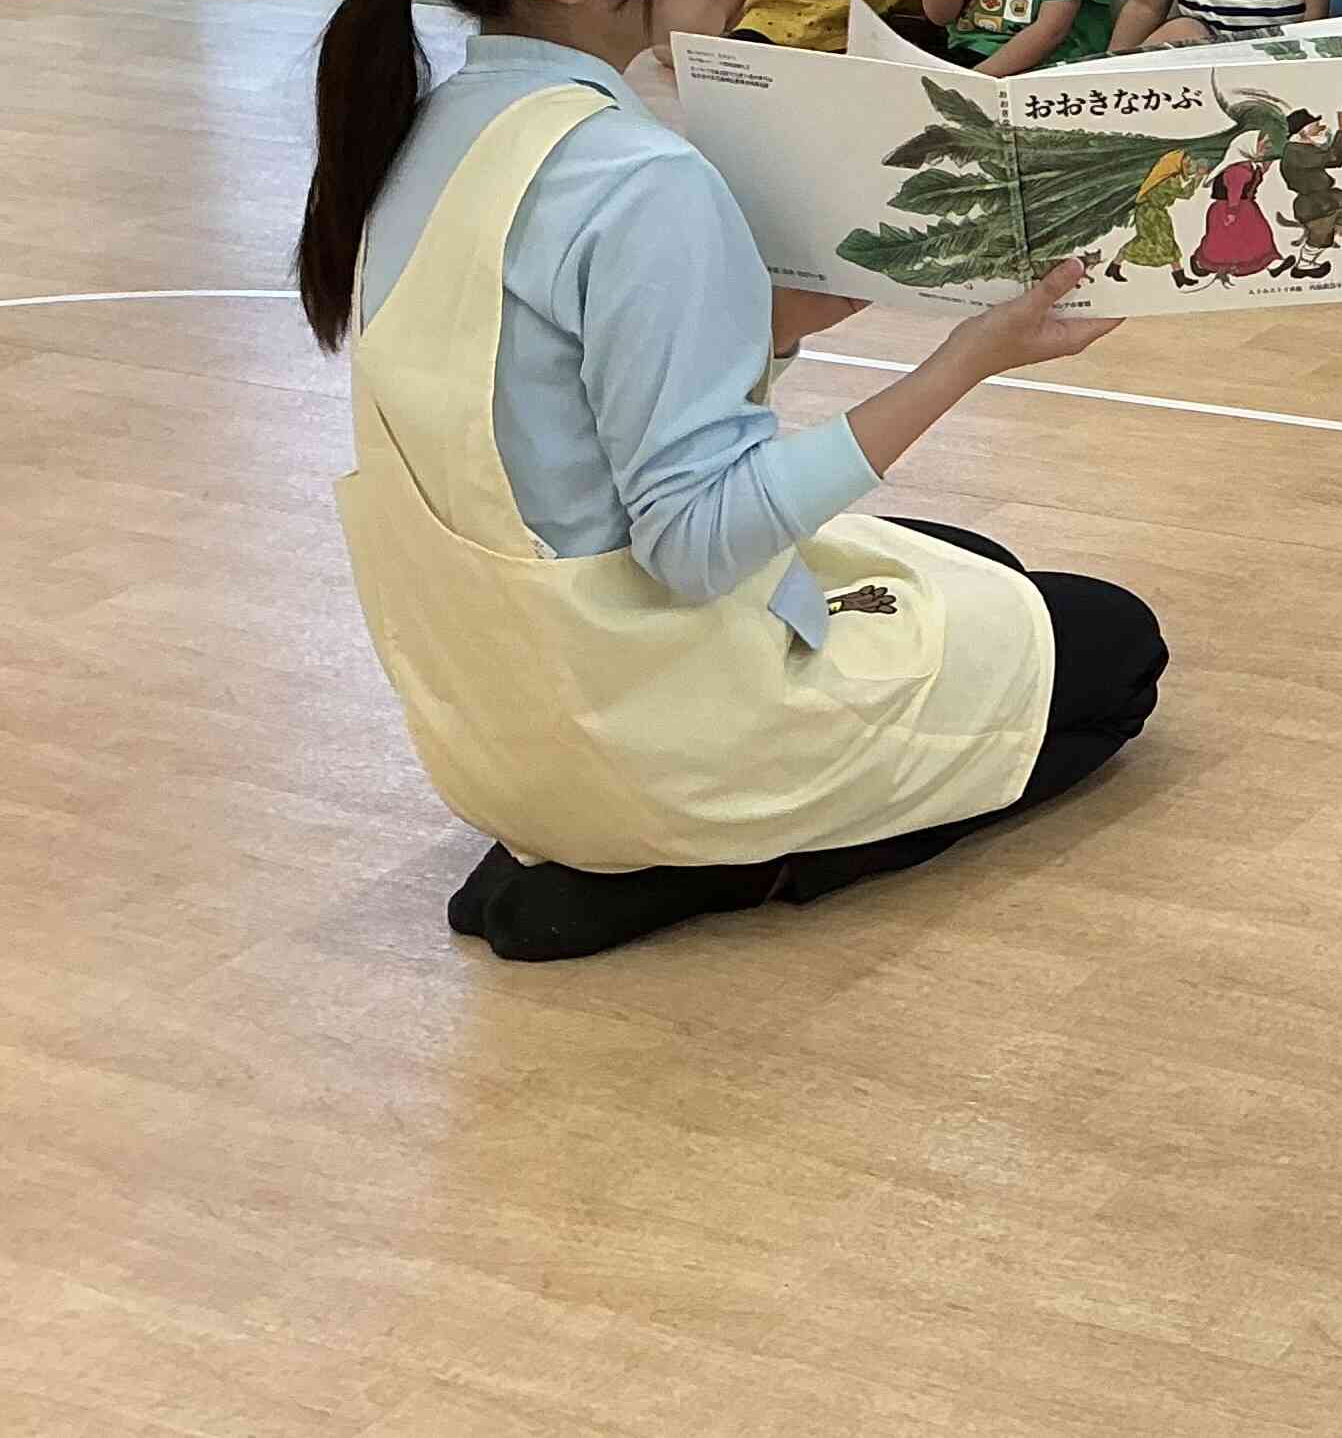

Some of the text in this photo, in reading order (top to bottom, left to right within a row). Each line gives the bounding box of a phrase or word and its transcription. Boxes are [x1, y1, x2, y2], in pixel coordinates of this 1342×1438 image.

[1024, 86, 1203, 120] おおきなかぶ
